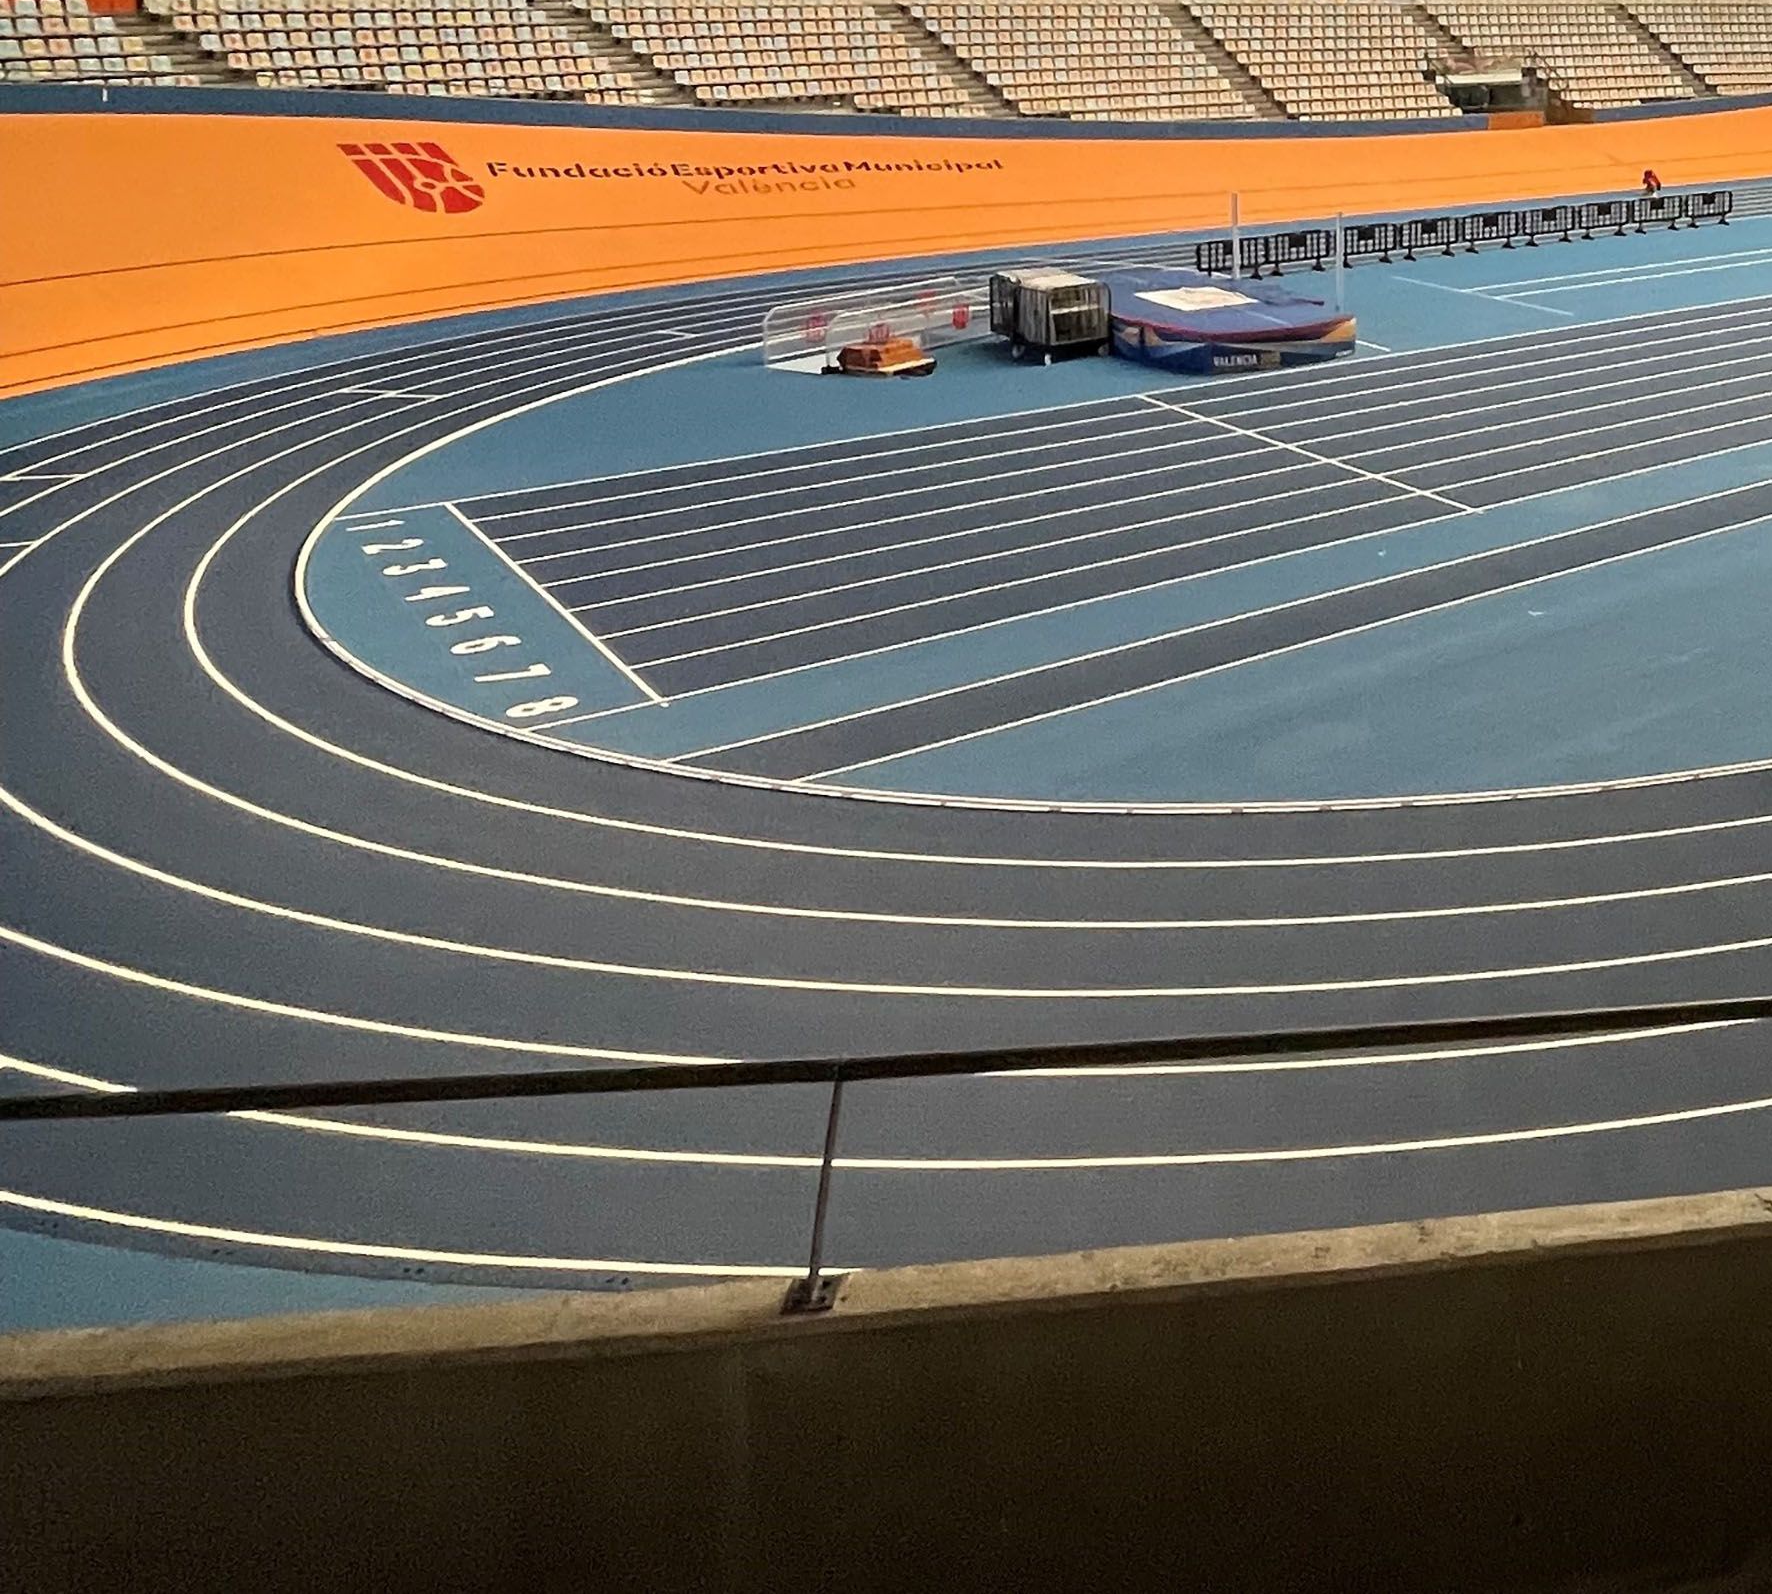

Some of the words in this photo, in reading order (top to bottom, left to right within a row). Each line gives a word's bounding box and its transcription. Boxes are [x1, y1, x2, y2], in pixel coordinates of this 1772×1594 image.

[346, 519, 405, 532] 1
[361, 538, 424, 555] 2
[382, 558, 448, 576] 3
[404, 586, 471, 602] 4
[425, 606, 495, 626] 5
[450, 635, 522, 655] 6
[474, 663, 552, 682] 7
[505, 696, 579, 718] 8
